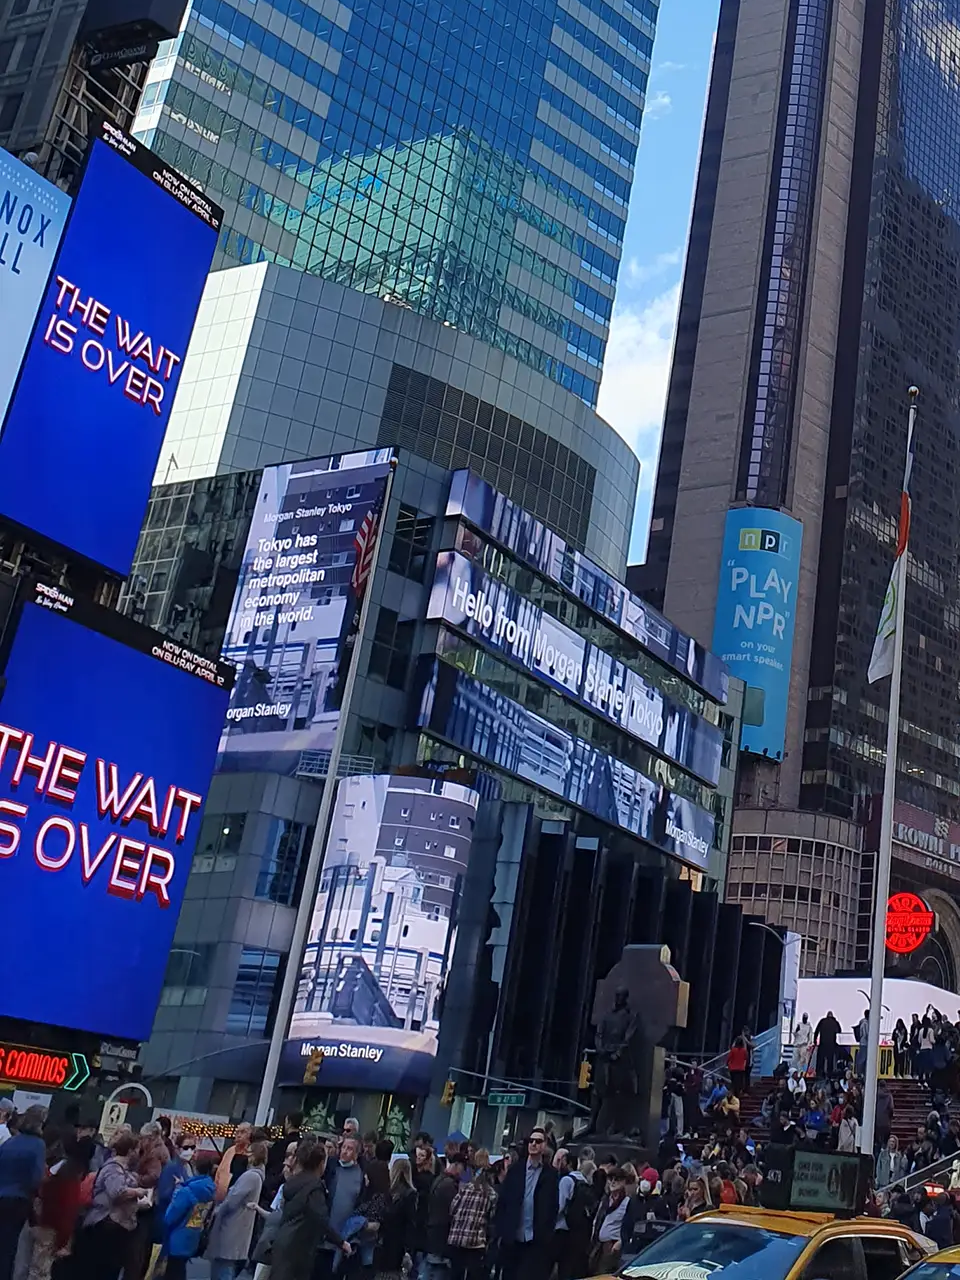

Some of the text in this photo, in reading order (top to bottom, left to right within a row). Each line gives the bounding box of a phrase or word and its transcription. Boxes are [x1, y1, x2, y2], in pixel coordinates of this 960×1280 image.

[152, 171, 165, 184] ON
[162, 169, 213, 216] NOW ON DIGITAL
[56, 275, 181, 381] THE WAIT
[44, 313, 165, 416] IS OVER
[263, 502, 353, 523] Morgan Stanley Tokyo
[258, 533, 318, 553] Tokyo has
[744, 532, 789, 555] npr
[253, 549, 319, 572] the largest
[248, 568, 325, 590] metropolitan
[244, 590, 300, 609] economy
[240, 606, 314, 629] in the world.
[162, 640, 218, 674] NOW ON DIGITAL
[452, 577, 665, 737] Hello from Morgan Stanley Tokyo
[721, 651, 751, 662] smart
[740, 640, 776, 654] on your
[152, 646, 165, 658] ON
[195, 667, 215, 683] APRIL
[226, 701, 291, 722] organ Stanley
[0, 722, 203, 843] THE WAIT
[665, 818, 709, 858] Morgan Stanley
[34, 815, 176, 910] OVER
[300, 1042, 383, 1063] Moan Stanley
[6, 1049, 68, 1084] CAMINOS
